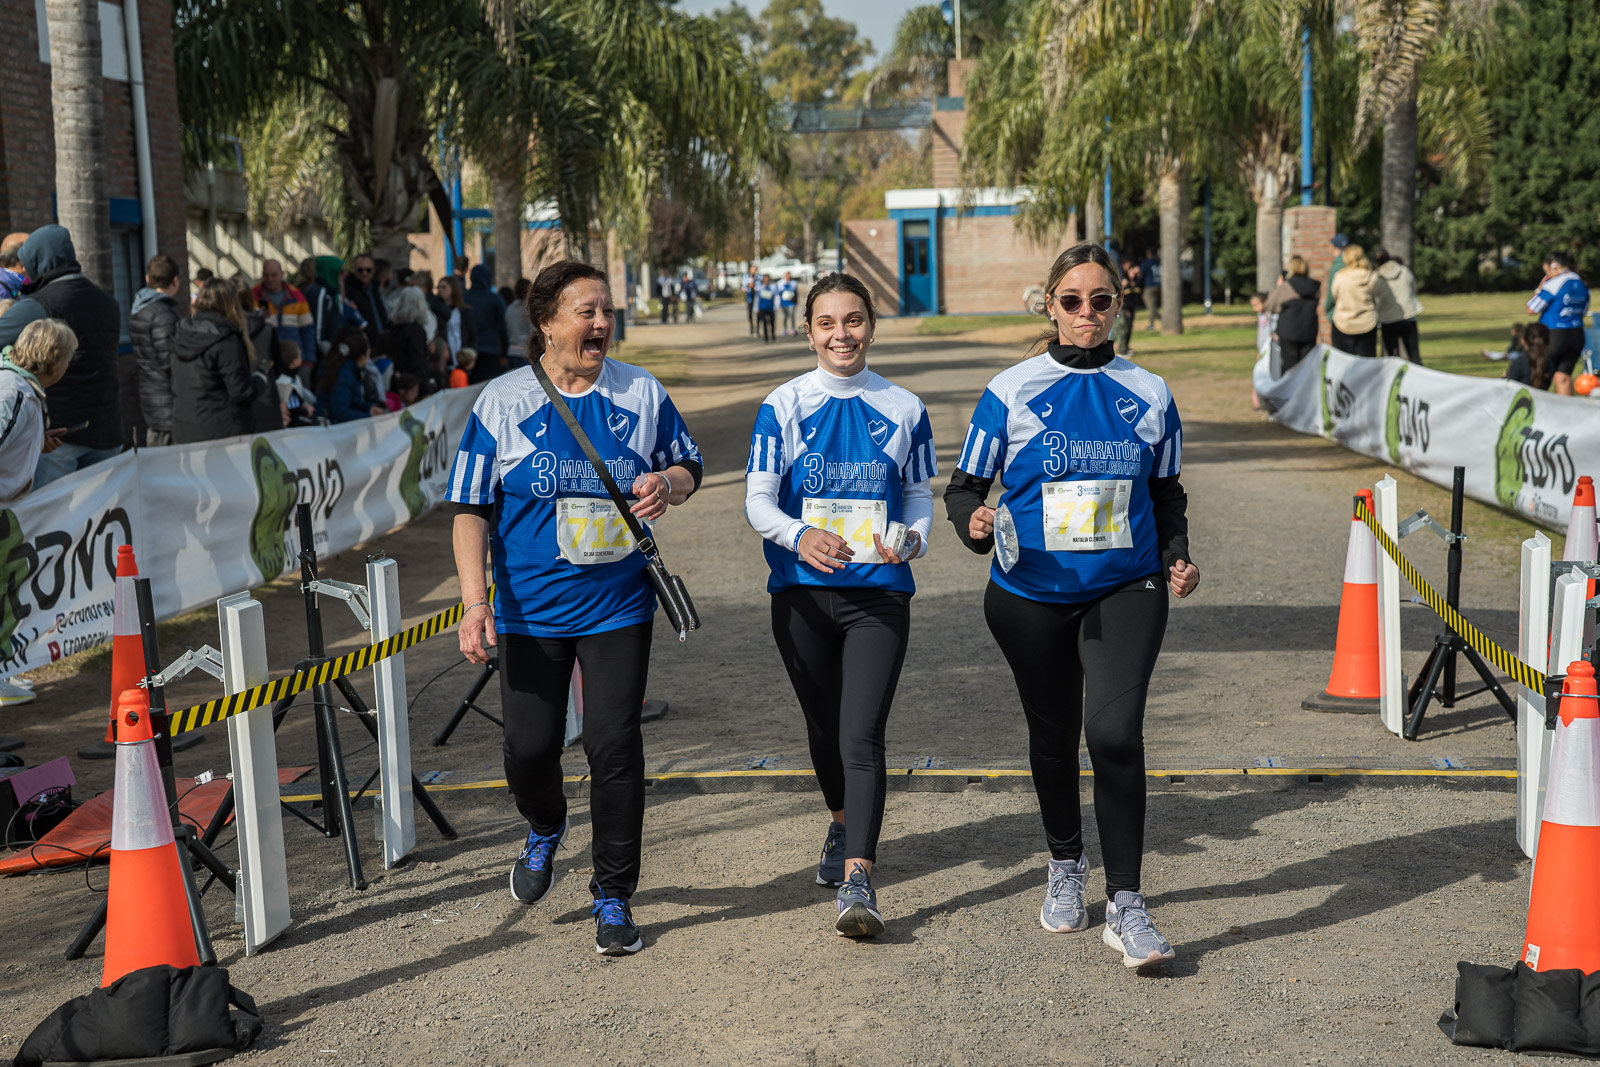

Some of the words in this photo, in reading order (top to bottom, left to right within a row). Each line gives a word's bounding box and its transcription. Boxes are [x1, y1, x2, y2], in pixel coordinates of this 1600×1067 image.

[531, 451, 557, 498] 3
[560, 456, 636, 480] MARTÓN
[803, 453, 824, 494] 3
[826, 460, 887, 480] MARATÓN
[1043, 431, 1067, 477] 3
[1070, 439, 1140, 461] MARATÓN
[568, 517, 631, 548] 712
[1055, 500, 1120, 534] 721
